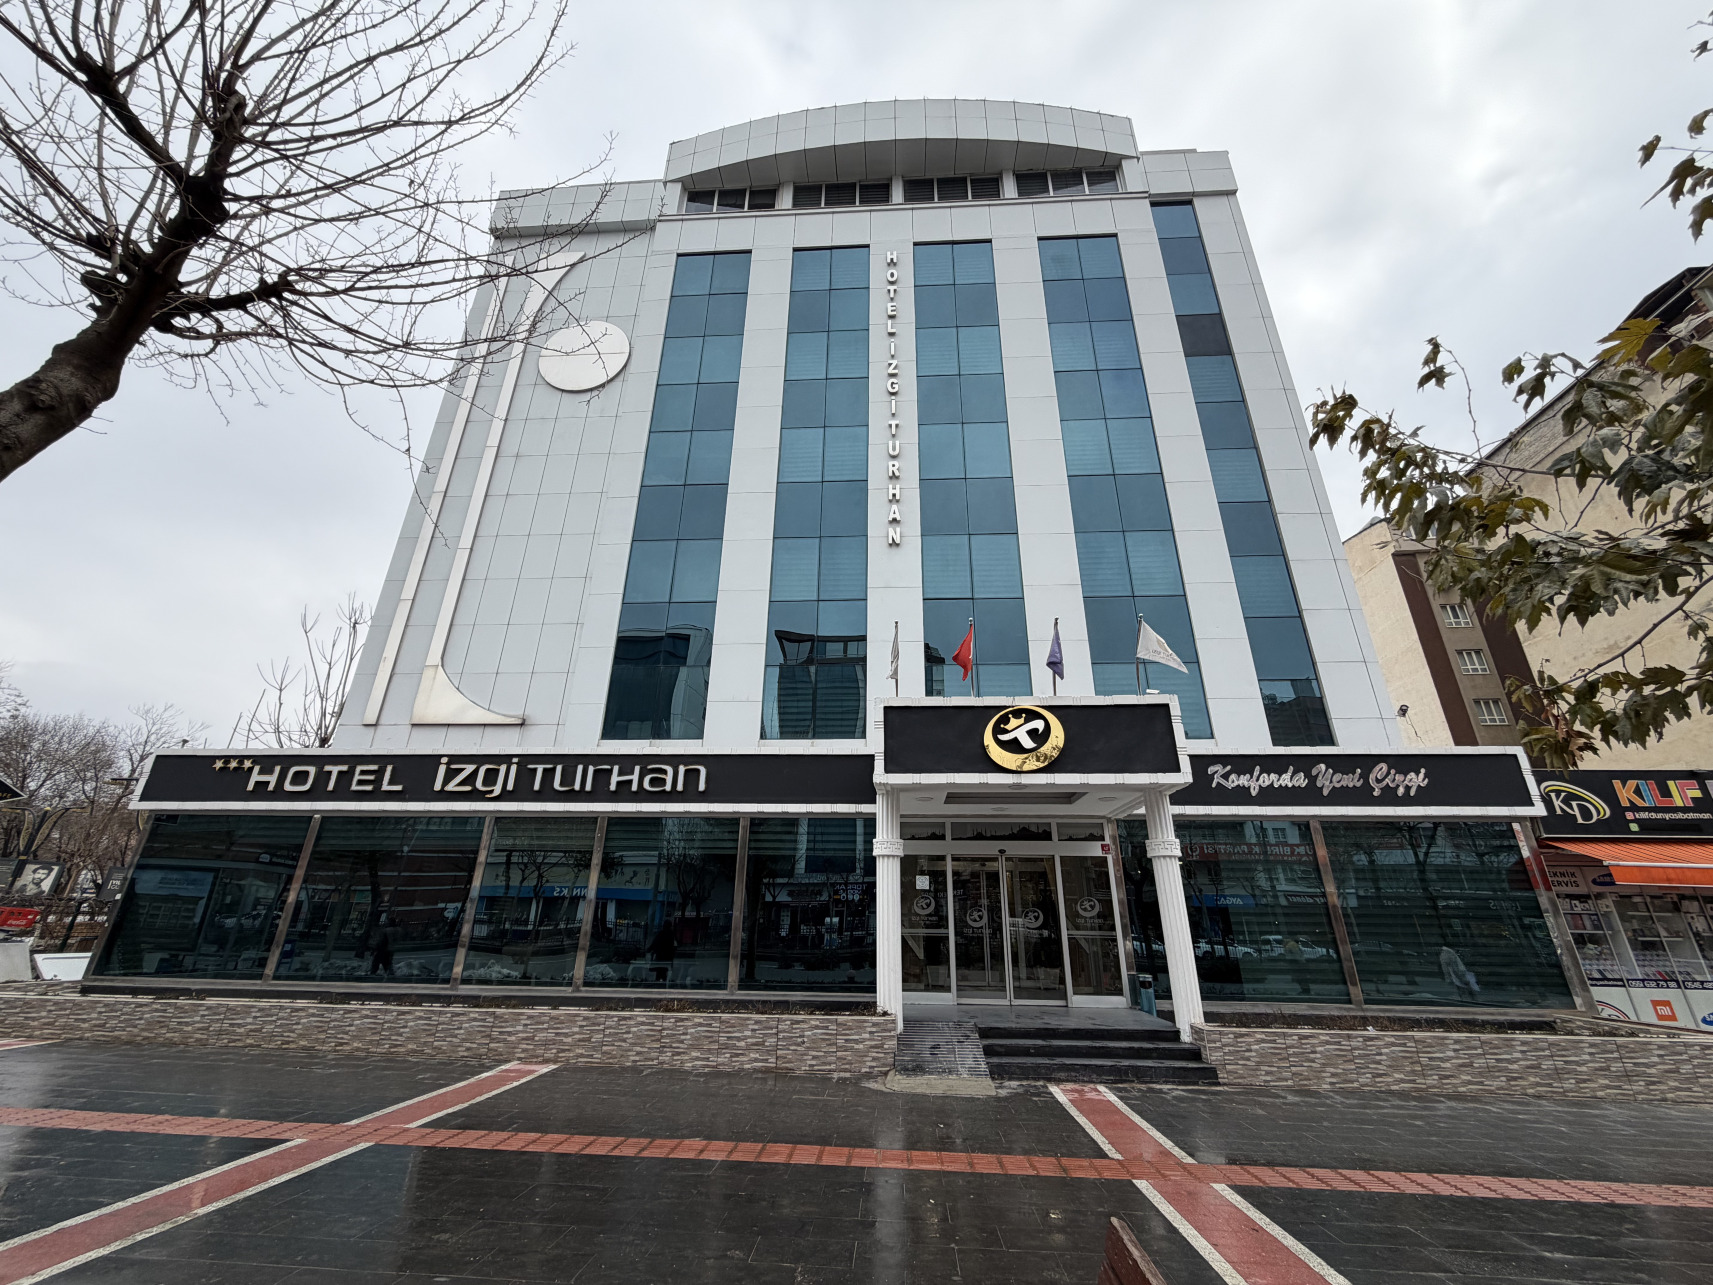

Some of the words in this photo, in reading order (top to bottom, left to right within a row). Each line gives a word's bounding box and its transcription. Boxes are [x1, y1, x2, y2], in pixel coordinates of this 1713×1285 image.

[886, 250, 898, 334] HOTEL
[888, 420, 901, 545] TURHAN
[246, 764, 403, 792] HOTEL
[1207, 763, 1308, 797] Konforda
[1311, 763, 1363, 797] Yeni
[1369, 762, 1429, 797] Çizgi
[1552, 879, 1580, 888] ERVİS
